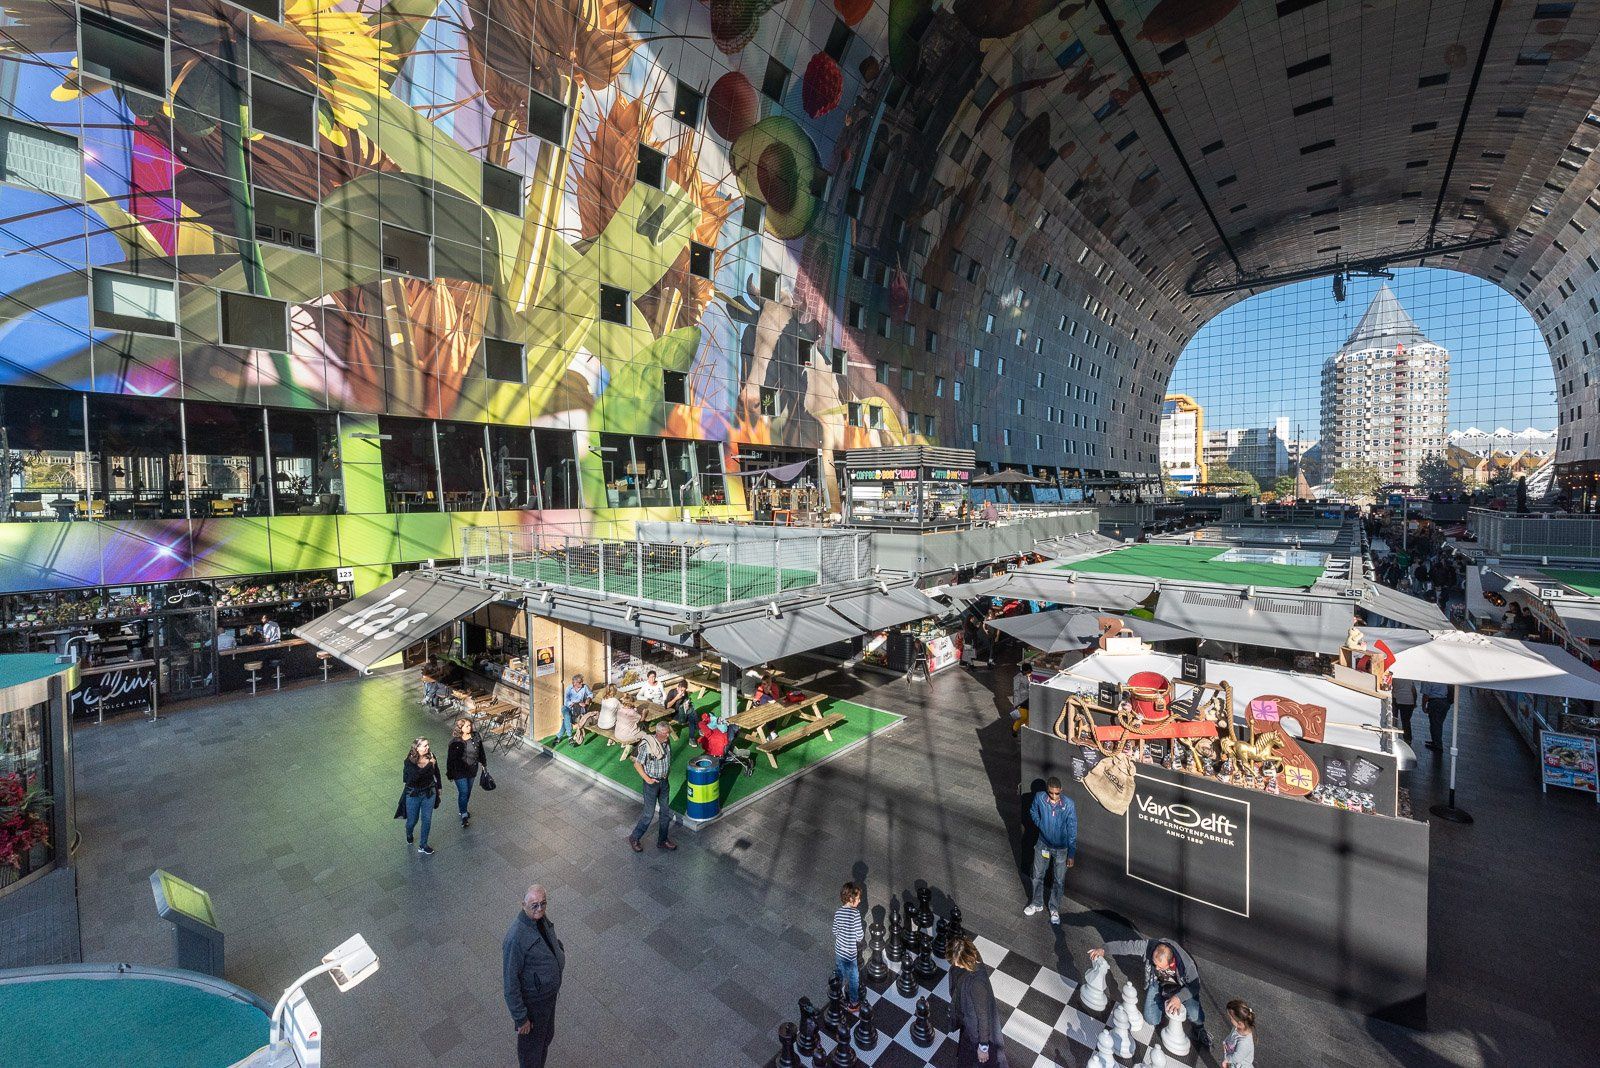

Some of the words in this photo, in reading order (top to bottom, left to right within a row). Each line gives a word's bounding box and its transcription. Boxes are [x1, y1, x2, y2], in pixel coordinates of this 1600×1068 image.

[752, 450, 763, 459] Bar
[340, 569, 353, 578] 123
[1346, 589, 1363, 597] 39
[337, 588, 428, 640] kas
[1136, 794, 1171, 820] Van
[1169, 803, 1238, 836] Delft
[1138, 813, 1149, 821] DE
[1150, 816, 1235, 847] PEPERNOTENFABRIEK
[1166, 829, 1186, 840] ANNO
